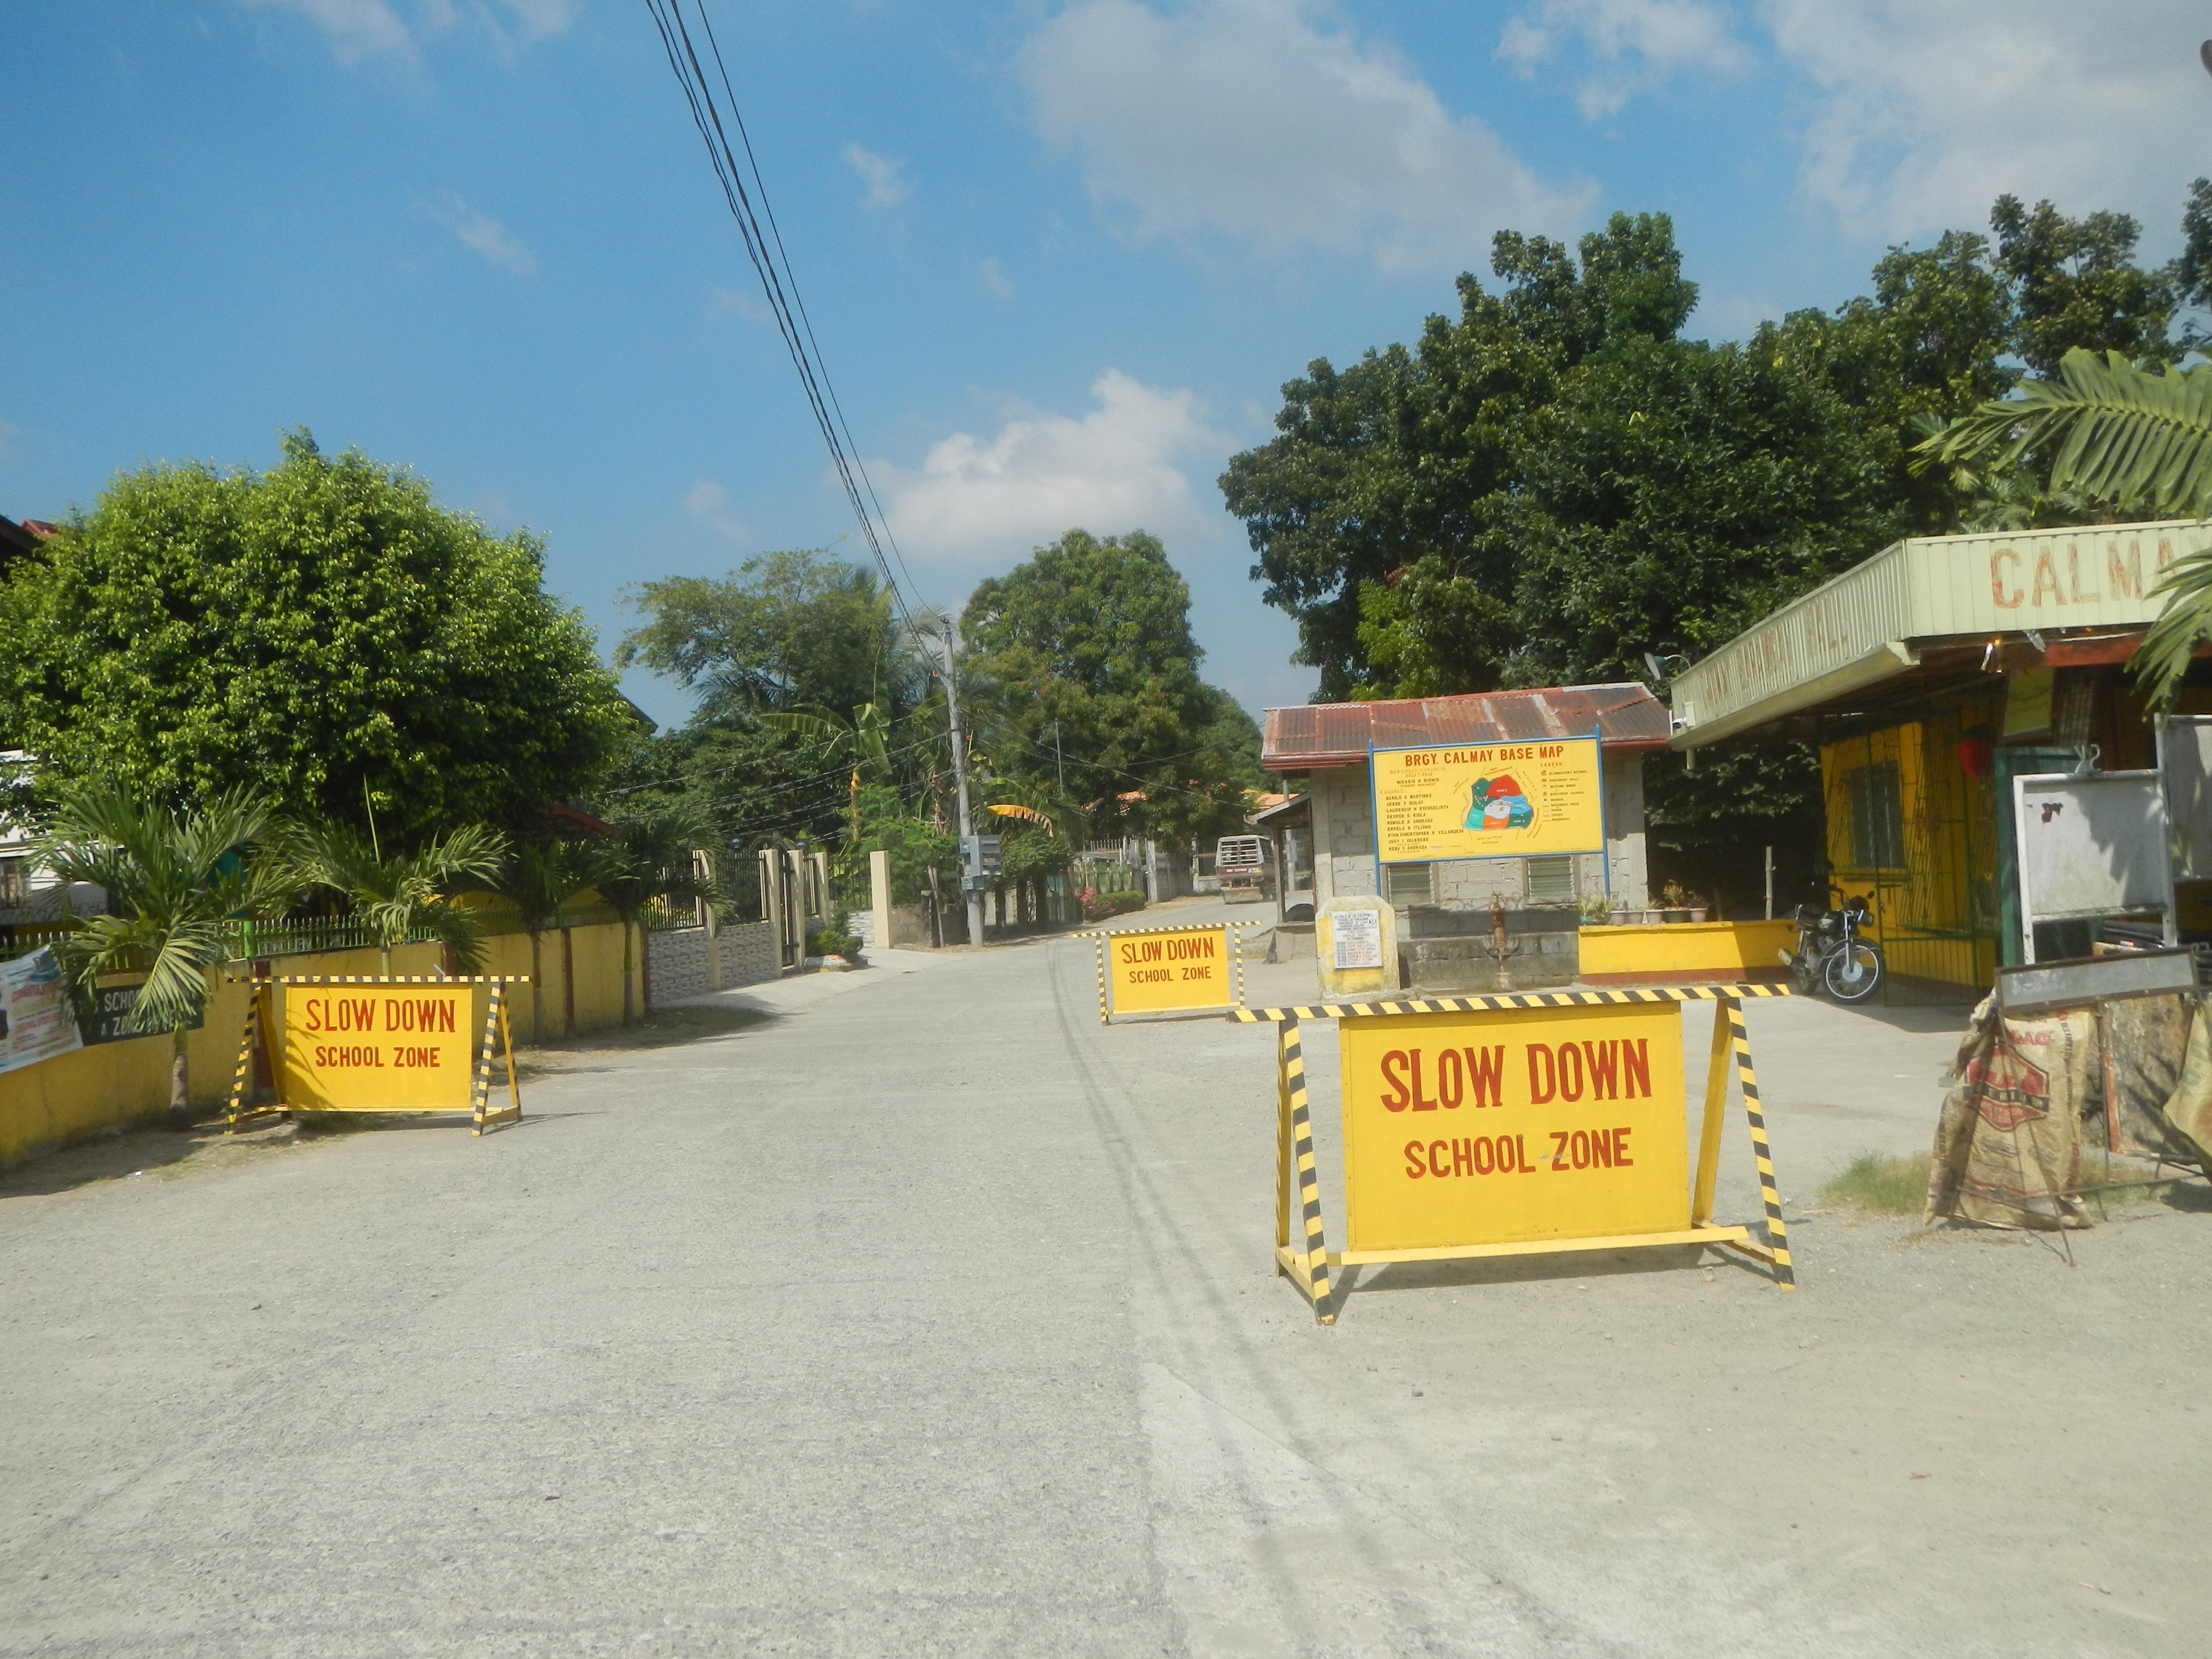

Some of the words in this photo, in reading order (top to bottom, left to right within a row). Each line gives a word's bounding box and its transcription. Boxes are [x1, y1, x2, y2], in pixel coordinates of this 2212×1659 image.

[1405, 753, 1439, 767] BRGY.
[1444, 750, 1493, 764] CALMAY
[1500, 747, 1533, 761] BASE
[1539, 745, 1564, 759] MAP
[1121, 940, 1162, 964] SLOW
[1167, 937, 1215, 961] DOWN
[1129, 969, 1174, 984] SCHOOL
[1181, 966, 1212, 980] ZONE
[305, 998, 376, 1032] SLOW
[385, 999, 456, 1033] DOWN
[314, 1046, 385, 1068] SCHOOL
[394, 1046, 440, 1068] ZONE
[1380, 1044, 1506, 1113] SLOW
[1526, 1038, 1652, 1105] DOWN
[1404, 1134, 1536, 1179] SCHOOL
[1549, 1127, 1634, 1171] ZONE
